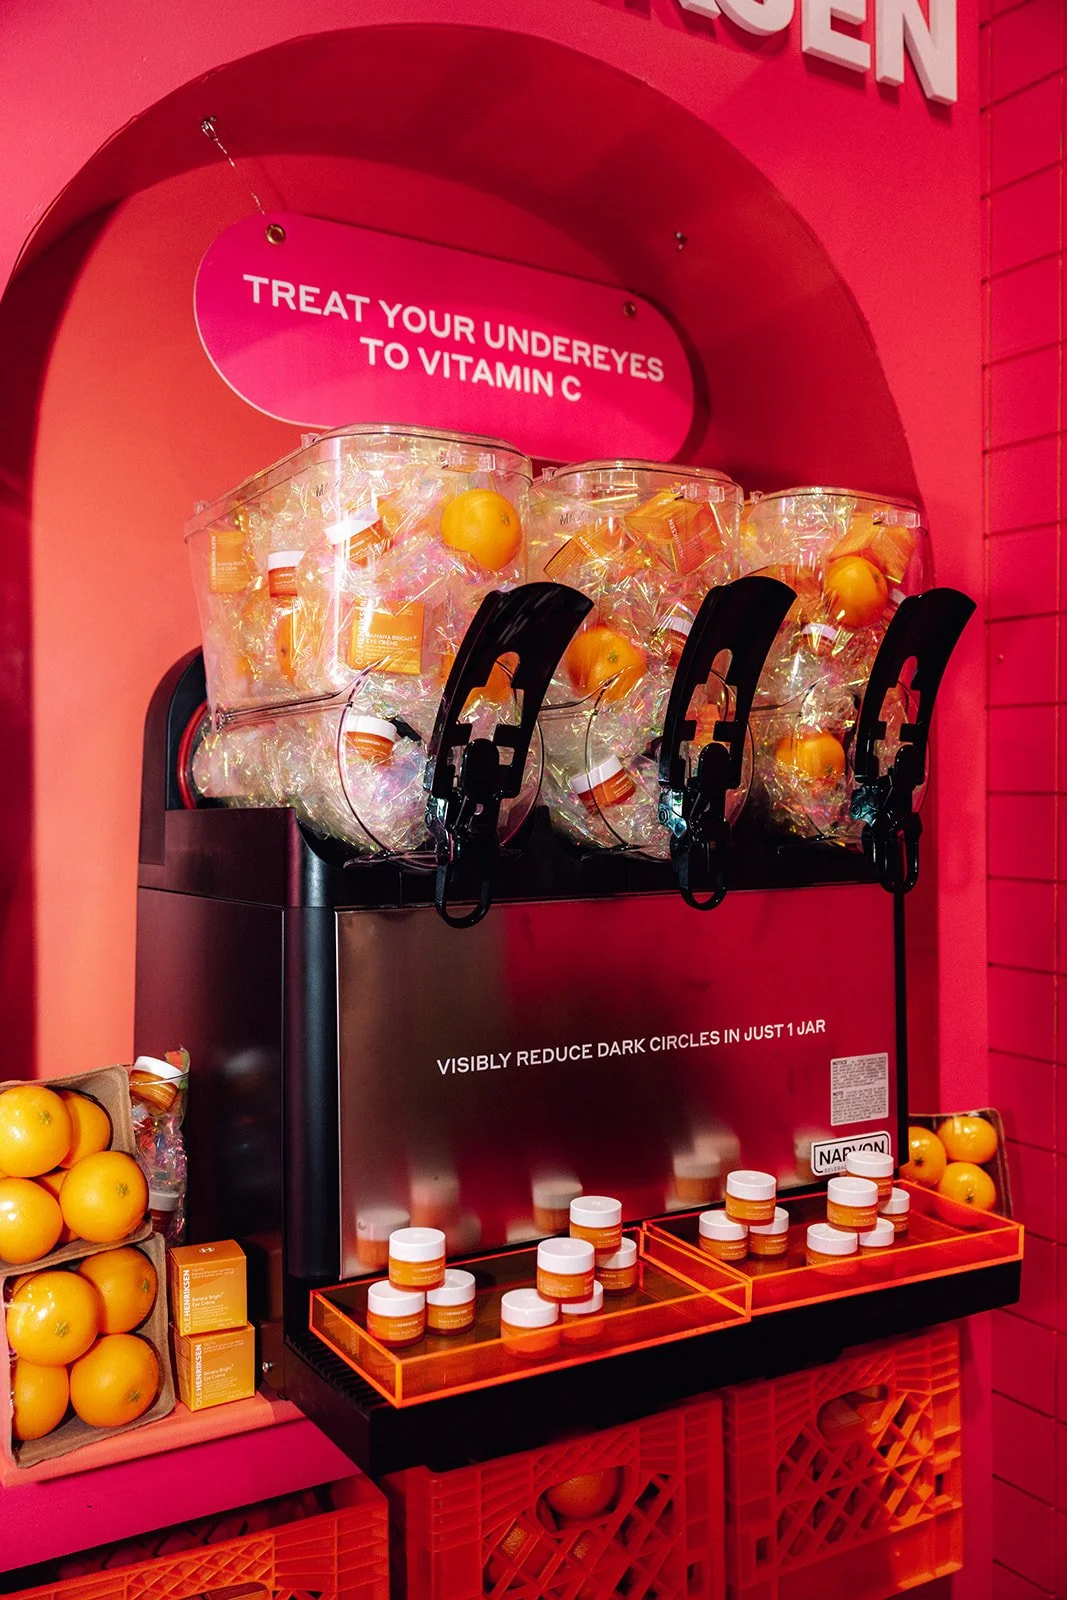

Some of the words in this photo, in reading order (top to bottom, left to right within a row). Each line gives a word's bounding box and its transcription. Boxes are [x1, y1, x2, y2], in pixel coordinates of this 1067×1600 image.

[243, 273, 370, 322] TREAT
[378, 299, 475, 344] YOUR
[483, 320, 665, 383] UNDEREYES
[359, 336, 410, 371] TO
[417, 346, 554, 398] VITAMIN
[560, 375, 582, 402] C
[436, 1051, 512, 1075] VISIBLY
[516, 1043, 593, 1067] REDUCE
[597, 1037, 646, 1059] DARK
[650, 1030, 720, 1052] CIRCLES
[724, 1028, 740, 1044] IN
[744, 1023, 784, 1042] JUST
[786, 1022, 794, 1037] 1
[797, 1019, 827, 1036] JAR
[183, 1269, 191, 1333] OLEHENRIKSEN
[195, 1344, 203, 1407] OLEHENRIKSEN
